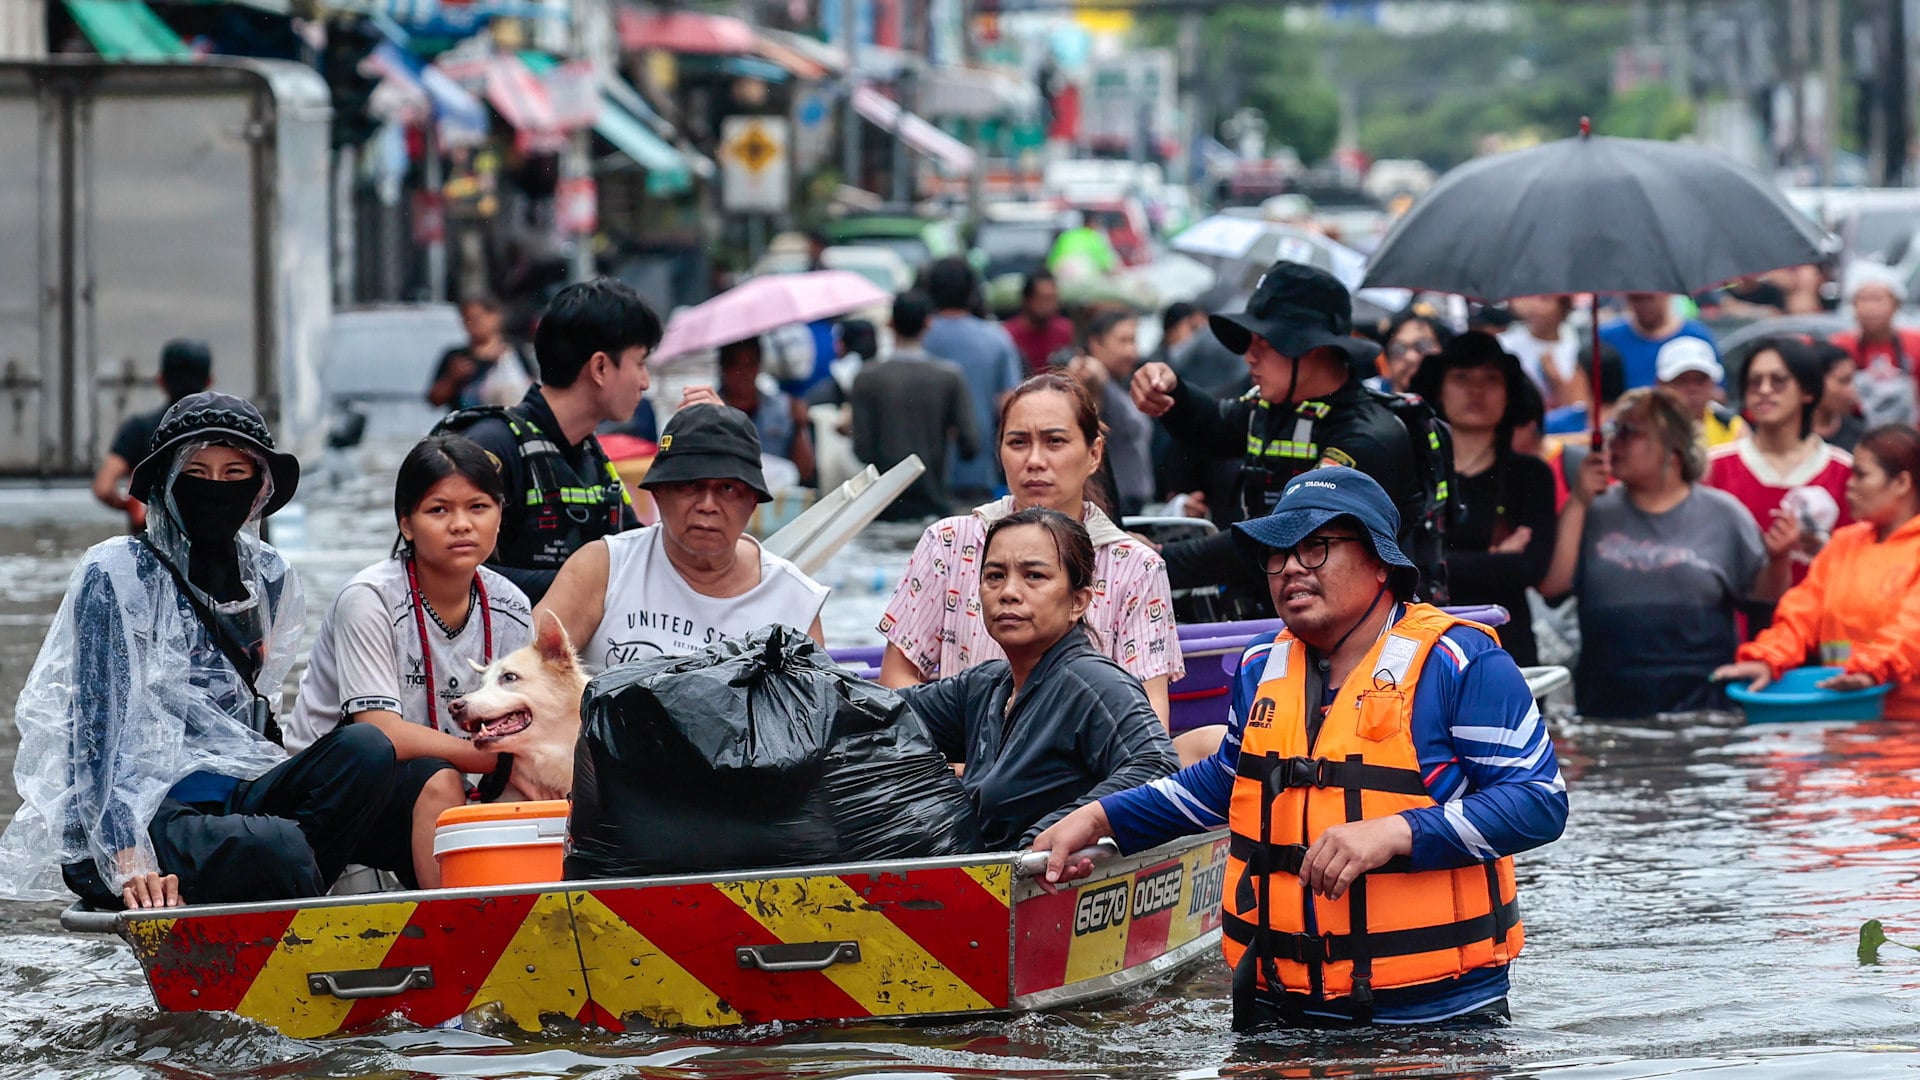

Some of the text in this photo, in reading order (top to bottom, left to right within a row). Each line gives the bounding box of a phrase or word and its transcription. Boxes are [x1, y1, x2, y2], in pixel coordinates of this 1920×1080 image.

[1304, 481, 1337, 490] TADANO
[628, 609, 694, 636] UNITED
[1076, 883, 1128, 935] 6670
[1133, 865, 1184, 918] 00562
